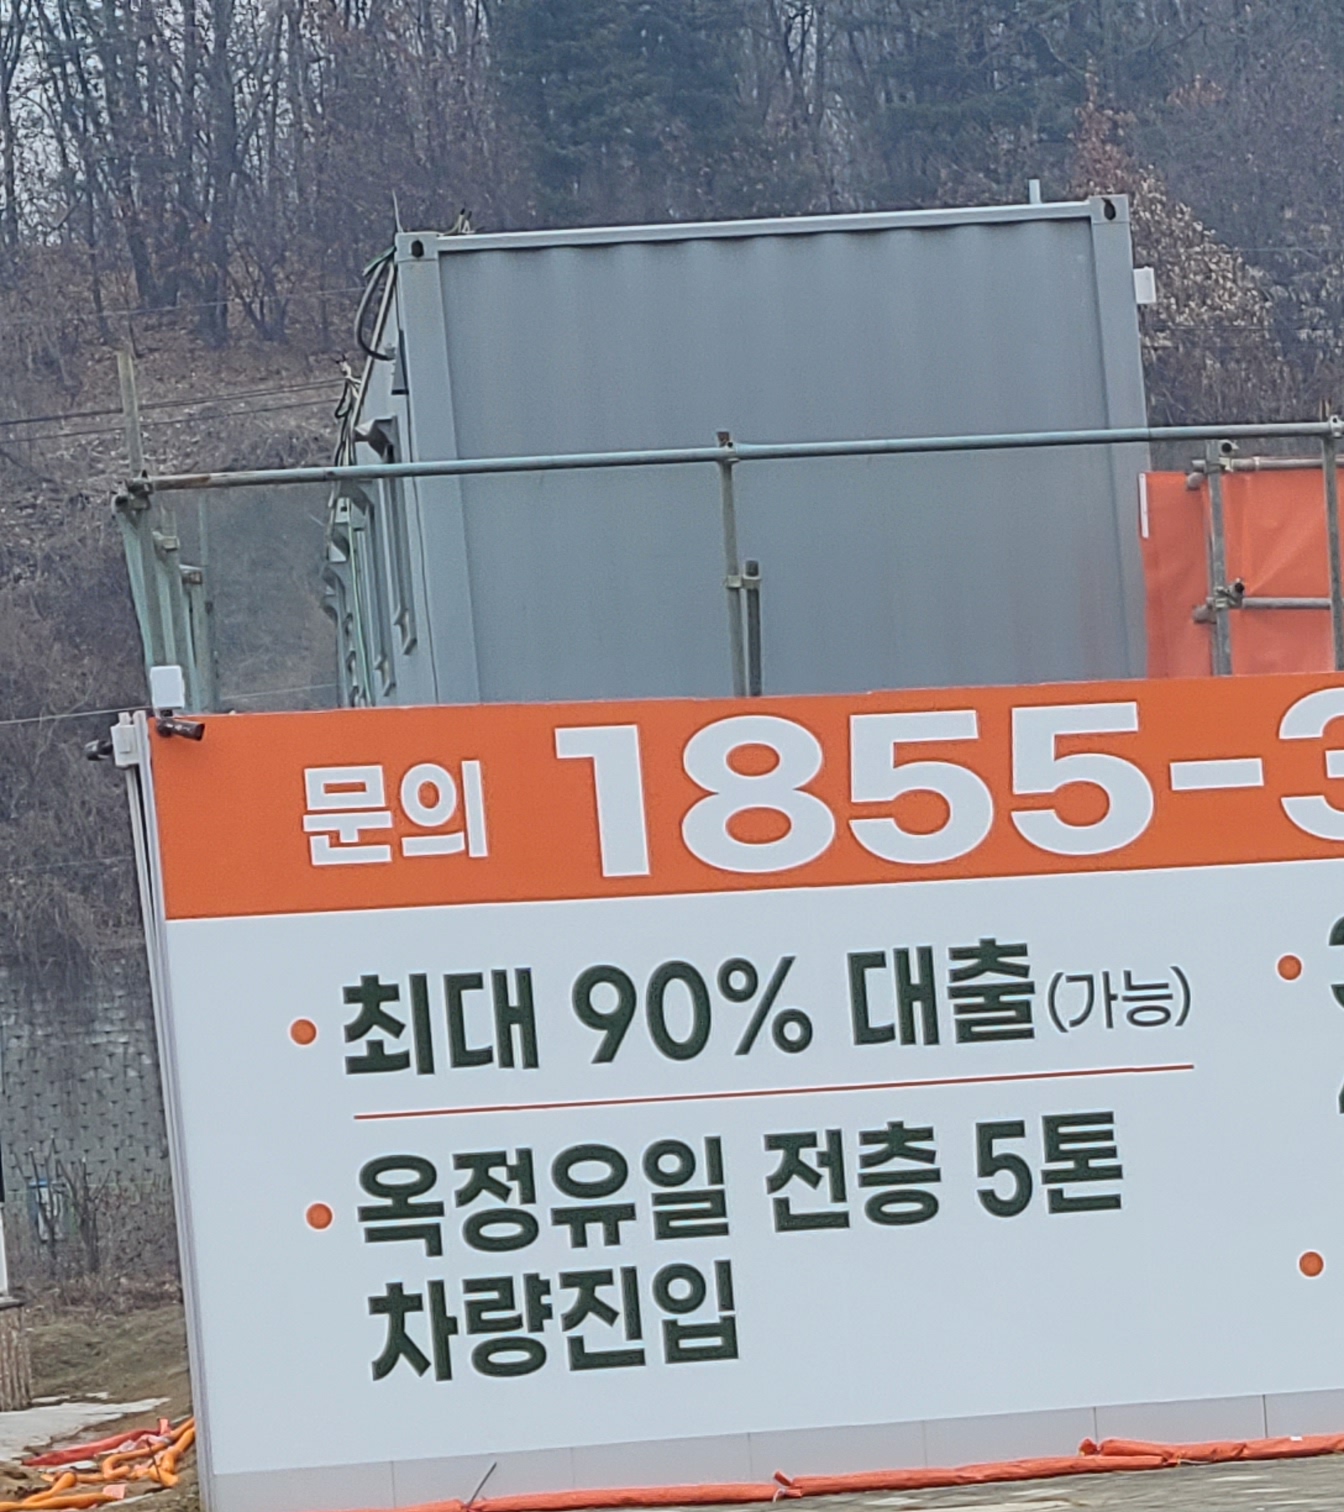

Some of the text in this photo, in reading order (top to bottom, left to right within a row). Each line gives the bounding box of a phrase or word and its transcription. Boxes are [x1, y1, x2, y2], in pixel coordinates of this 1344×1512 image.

[302, 760, 489, 866] 문의
[343, 967, 540, 1075] 최대
[572, 956, 813, 1064] 90%
[357, 1111, 1124, 1257] 옥정유일 전층 5톤
[368, 1259, 739, 1382] 차량진입
